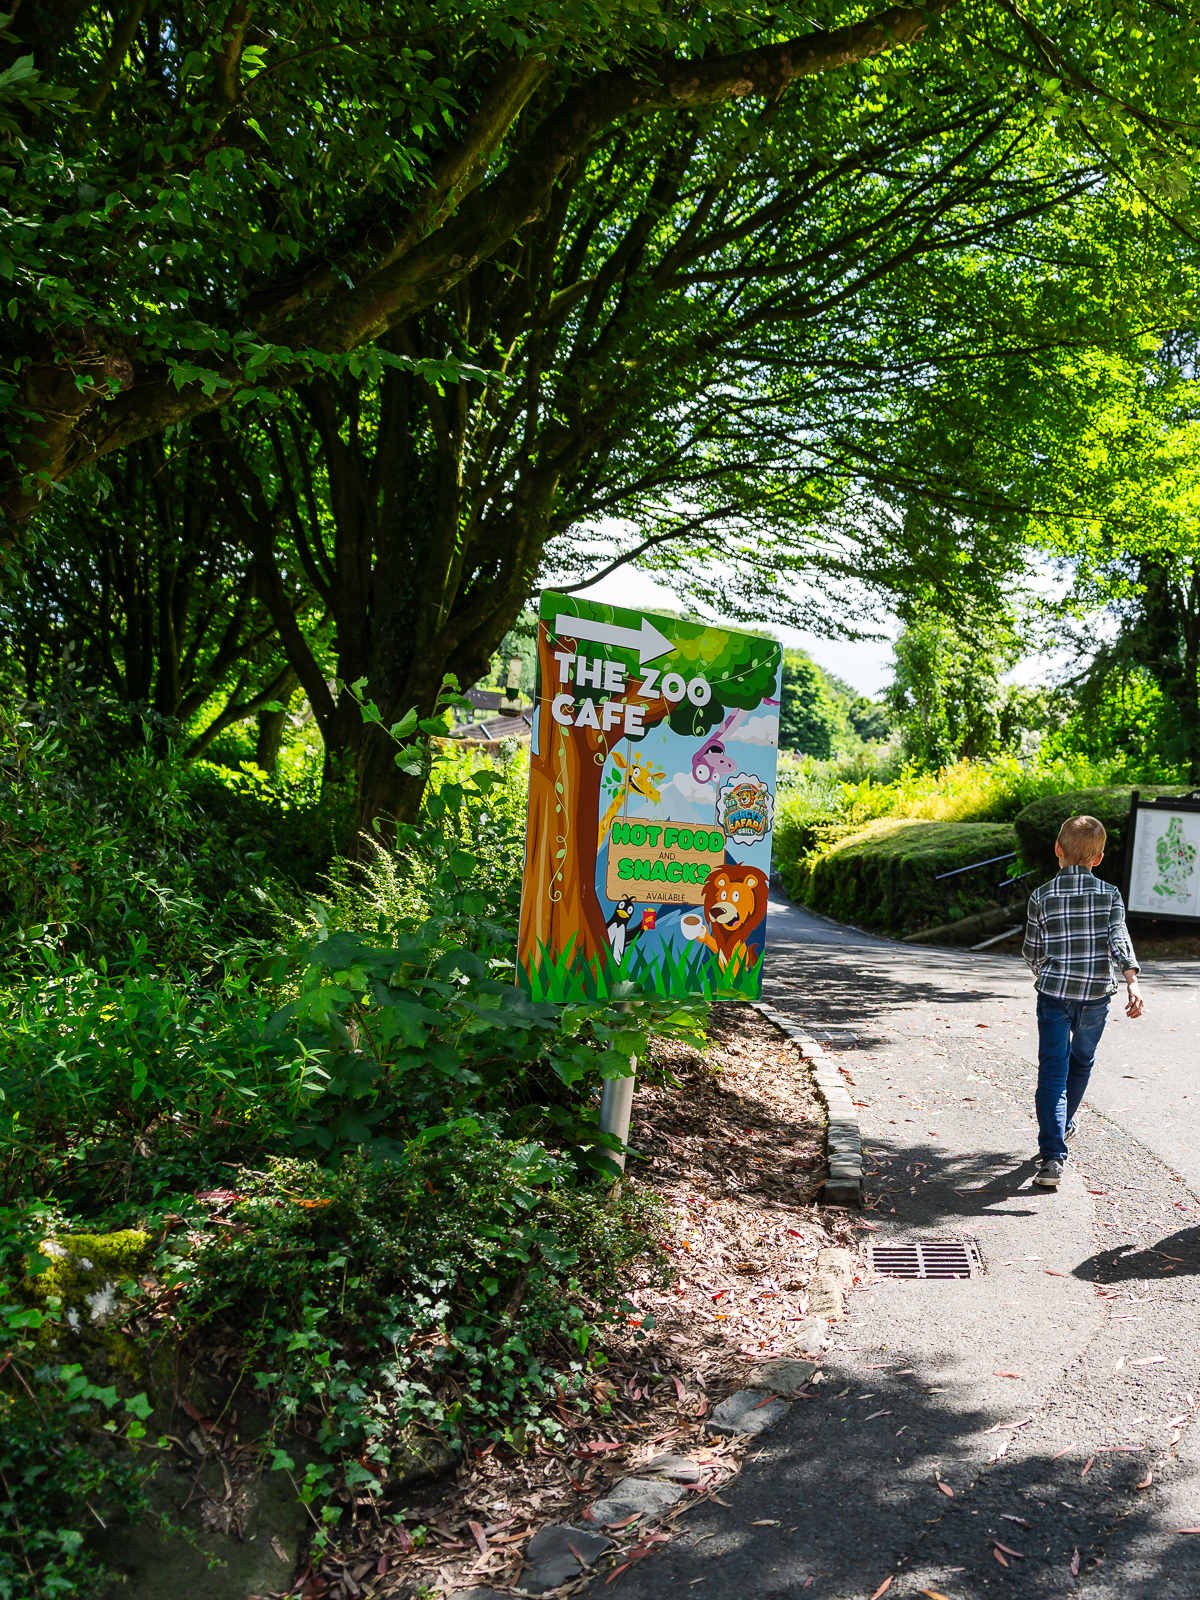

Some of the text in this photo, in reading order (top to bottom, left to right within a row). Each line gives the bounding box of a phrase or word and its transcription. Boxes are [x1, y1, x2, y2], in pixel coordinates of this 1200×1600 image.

[554, 652, 711, 706] THE ZOO
[552, 694, 645, 736] CAFE
[729, 810, 763, 823] PERCY'S
[729, 819, 762, 833] SAFARI
[612, 822, 724, 853] HOT FOOD
[659, 852, 675, 860] AND
[618, 858, 711, 885] SNACKS
[646, 893, 685, 901] AVAILABLE
